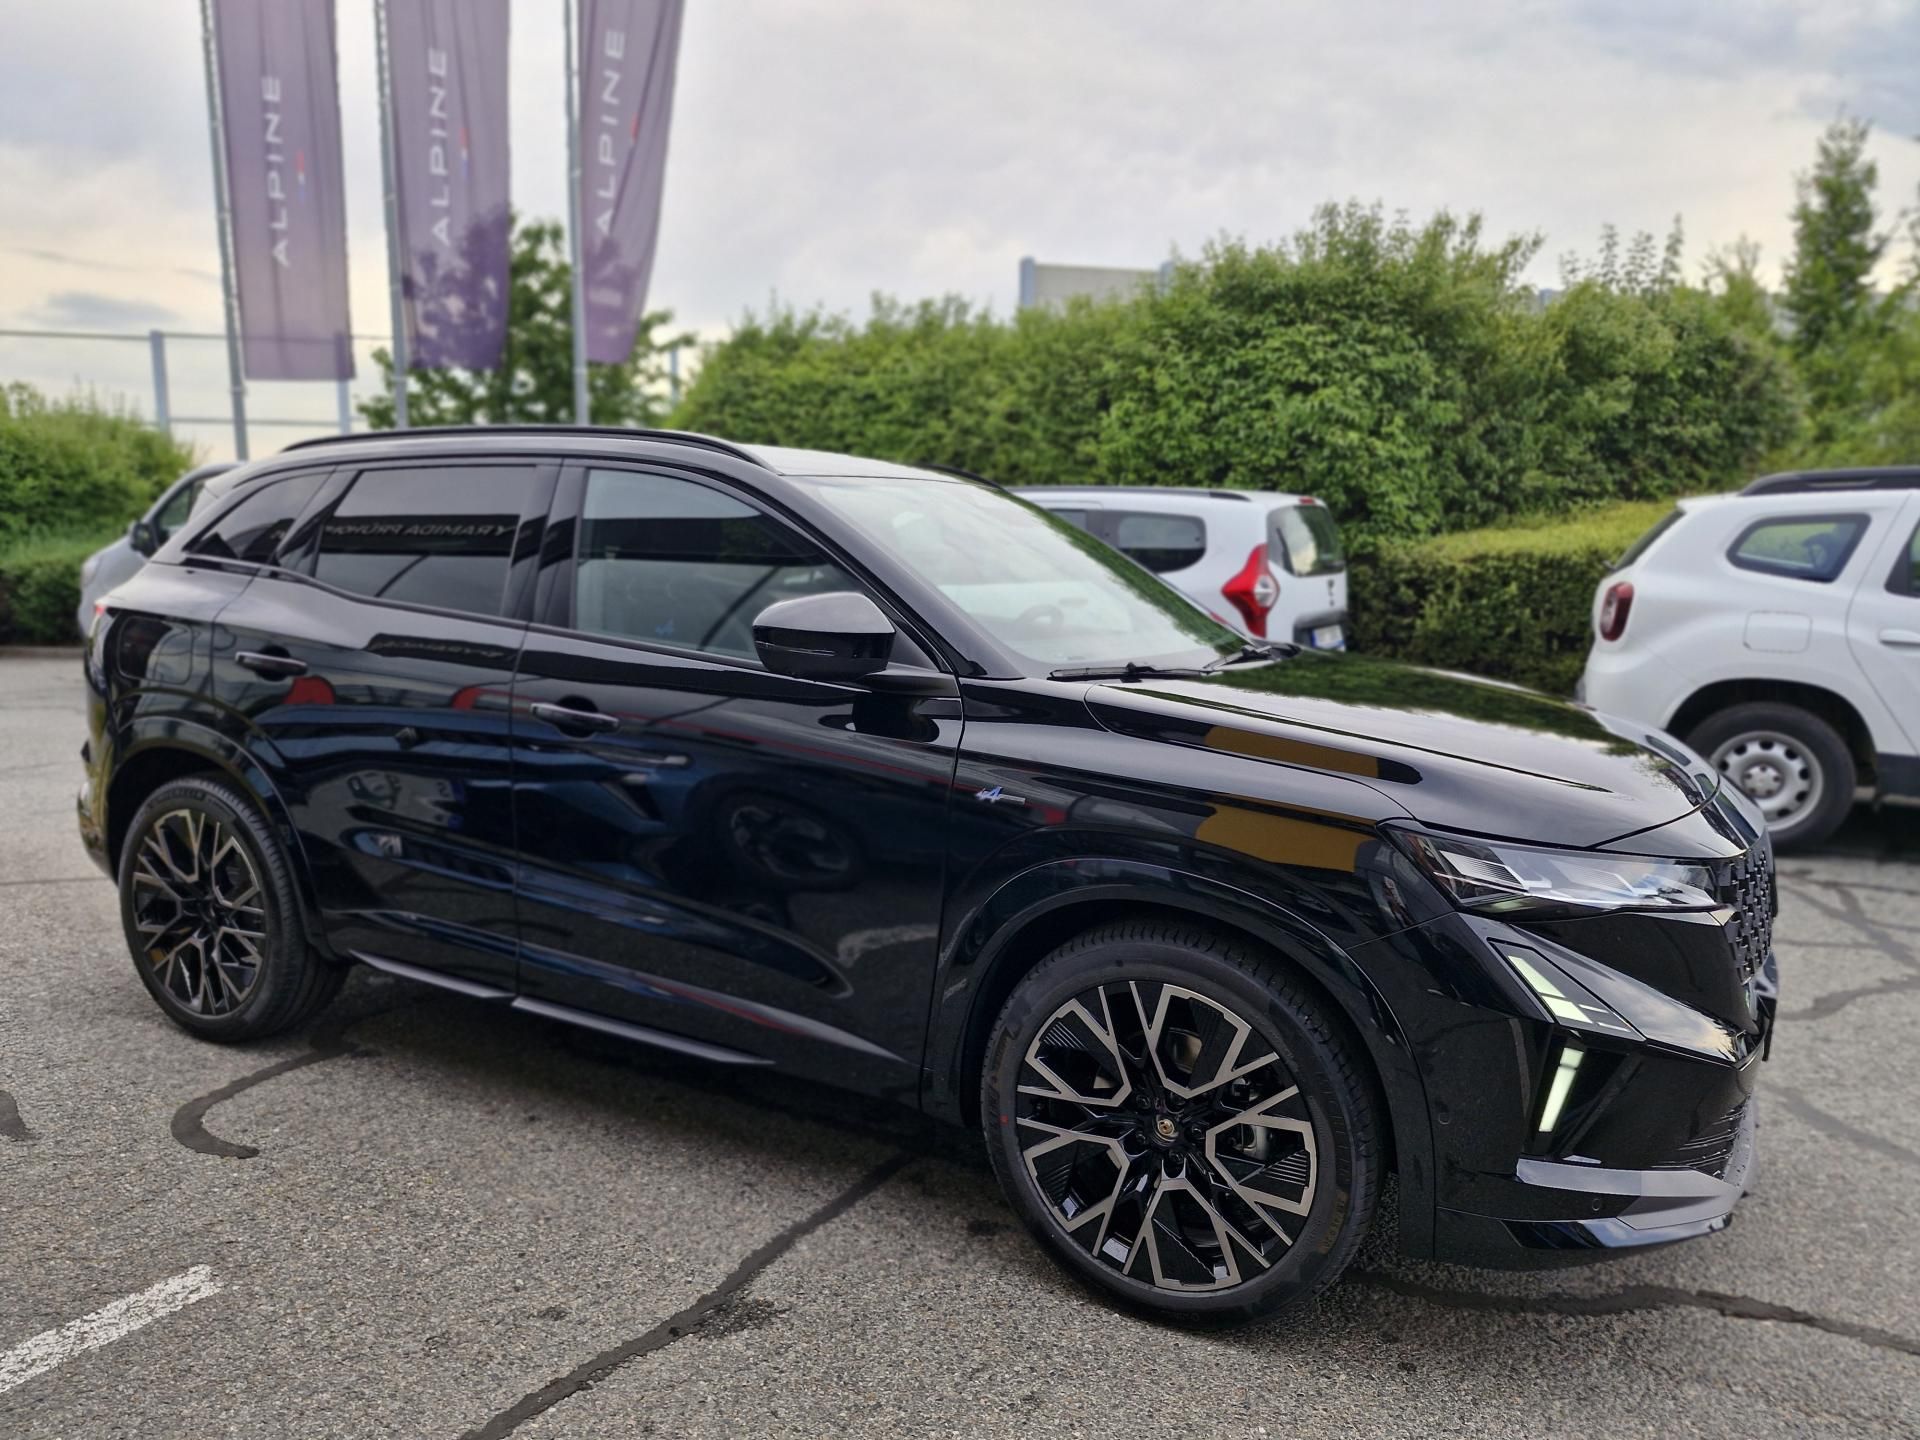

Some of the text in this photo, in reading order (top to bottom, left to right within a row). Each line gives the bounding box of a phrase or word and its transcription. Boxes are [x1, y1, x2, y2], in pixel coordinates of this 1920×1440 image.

[261, 76, 289, 269] ALPINE
[428, 48, 451, 248] ALPINE
[596, 29, 625, 236] ALPINE
